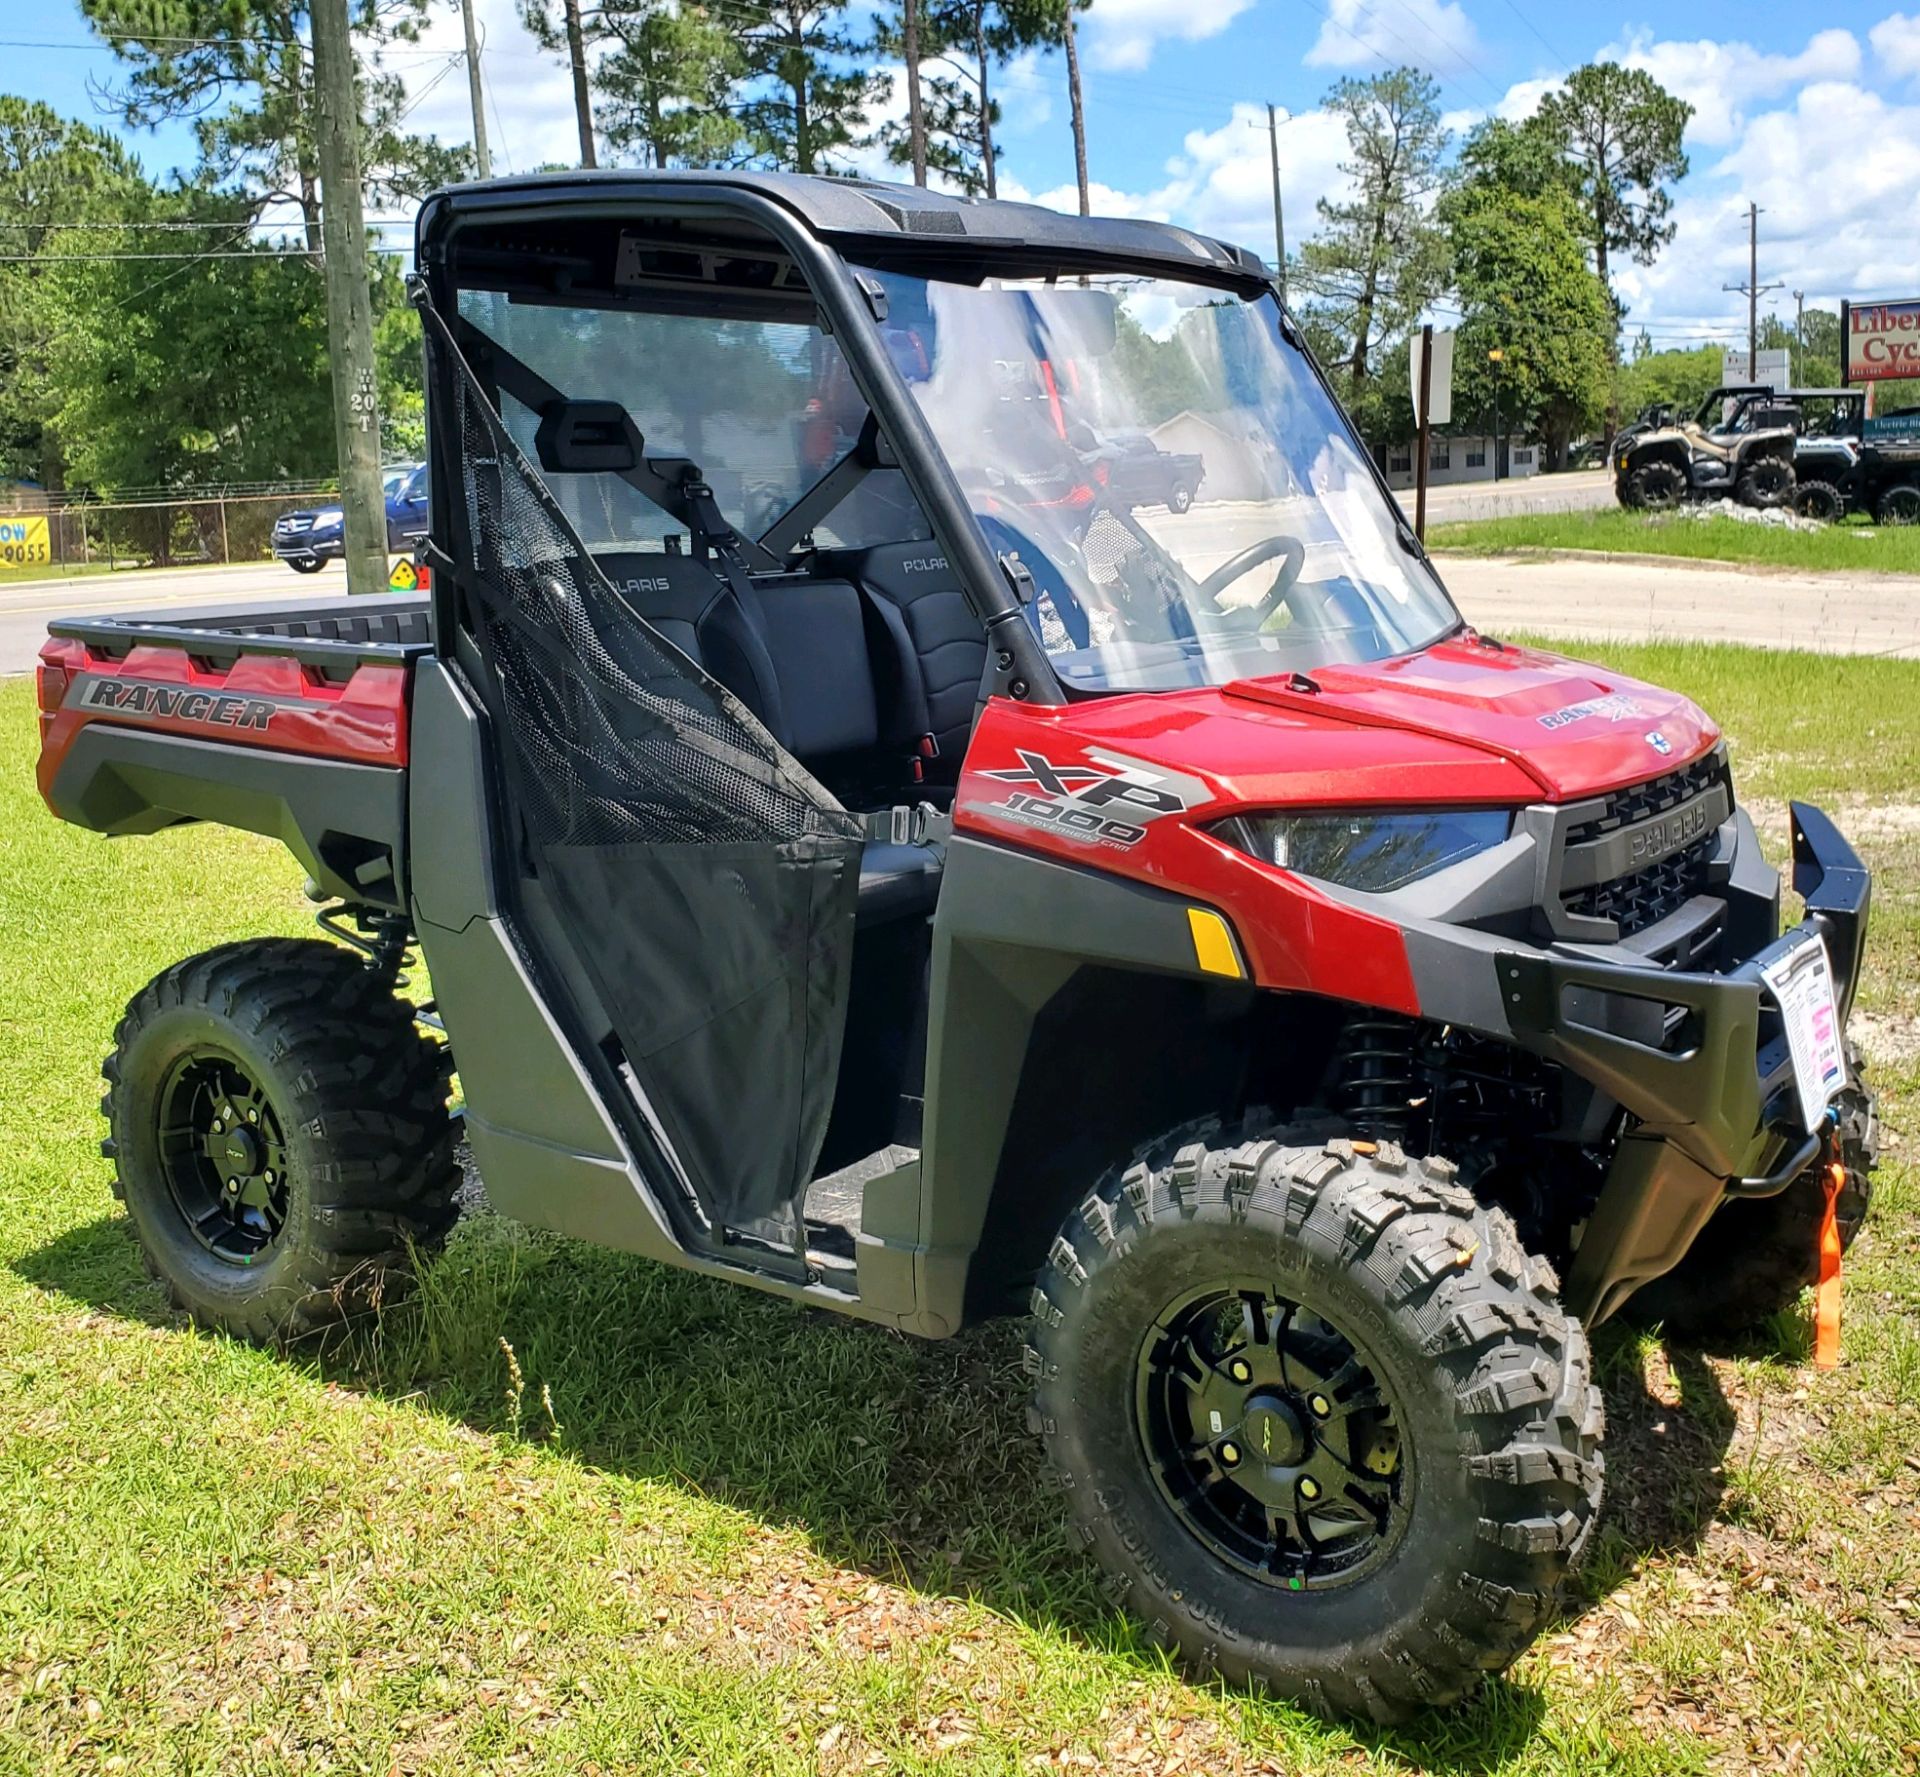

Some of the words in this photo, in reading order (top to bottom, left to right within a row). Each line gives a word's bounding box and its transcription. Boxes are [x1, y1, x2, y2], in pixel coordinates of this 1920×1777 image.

[350, 393, 375, 412] 20
[359, 415, 370, 432] T
[88, 678, 278, 732] RANGER
[971, 747, 1188, 815] XP
[1000, 810, 1031, 823] DUAL
[1032, 820, 1100, 843] OVERHEAD
[1100, 839, 1131, 852] CAM
[1004, 791, 1147, 845] 1000
[1629, 803, 1706, 865] POLARIS
